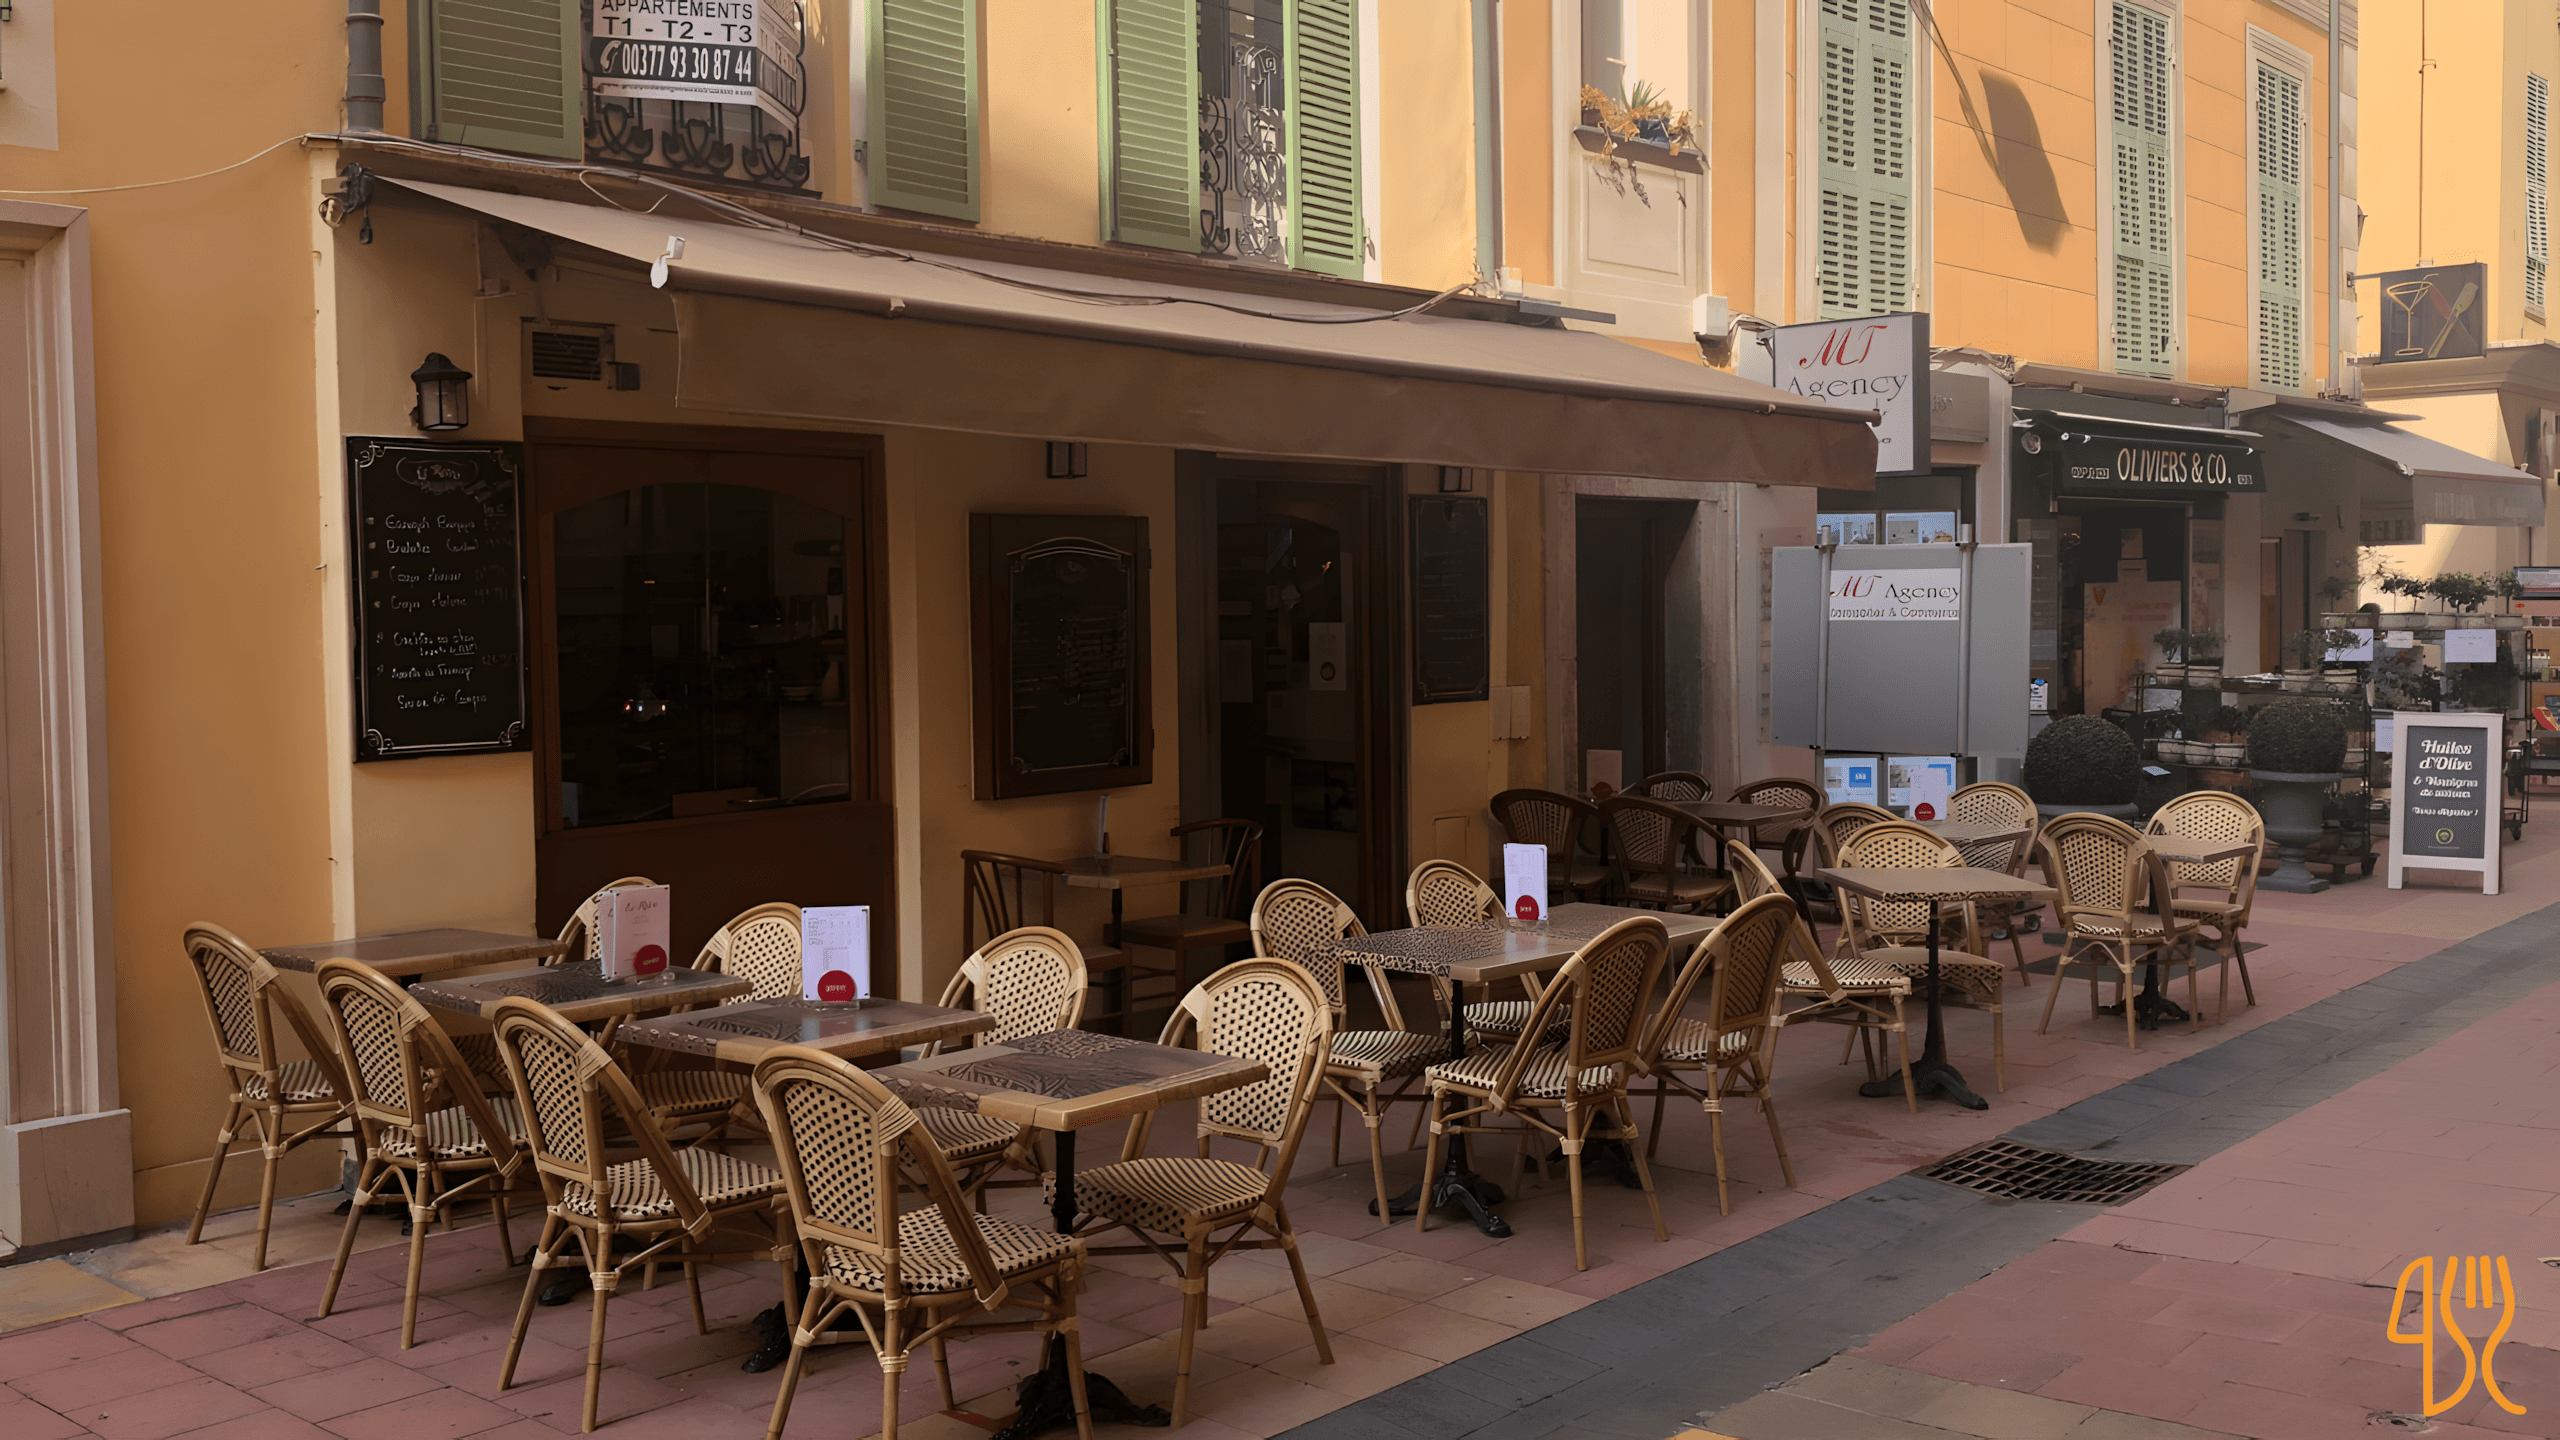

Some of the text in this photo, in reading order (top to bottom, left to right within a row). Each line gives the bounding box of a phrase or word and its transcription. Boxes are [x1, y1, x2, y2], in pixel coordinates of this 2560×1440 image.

[601, 0, 753, 20] APPARTEMENTS
[601, 16, 633, 36] T1
[661, 20, 694, 39] T2
[720, 23, 752, 43] T3
[622, 43, 752, 83] 00377 93 30 87 44
[1799, 325, 1888, 369] MT
[1788, 374, 1908, 402] Agency
[2117, 447, 2188, 483] OLIVIERS
[2191, 452, 2204, 483] &
[2207, 453, 2232, 484] CO.
[1829, 575, 1960, 604] MT Agency
